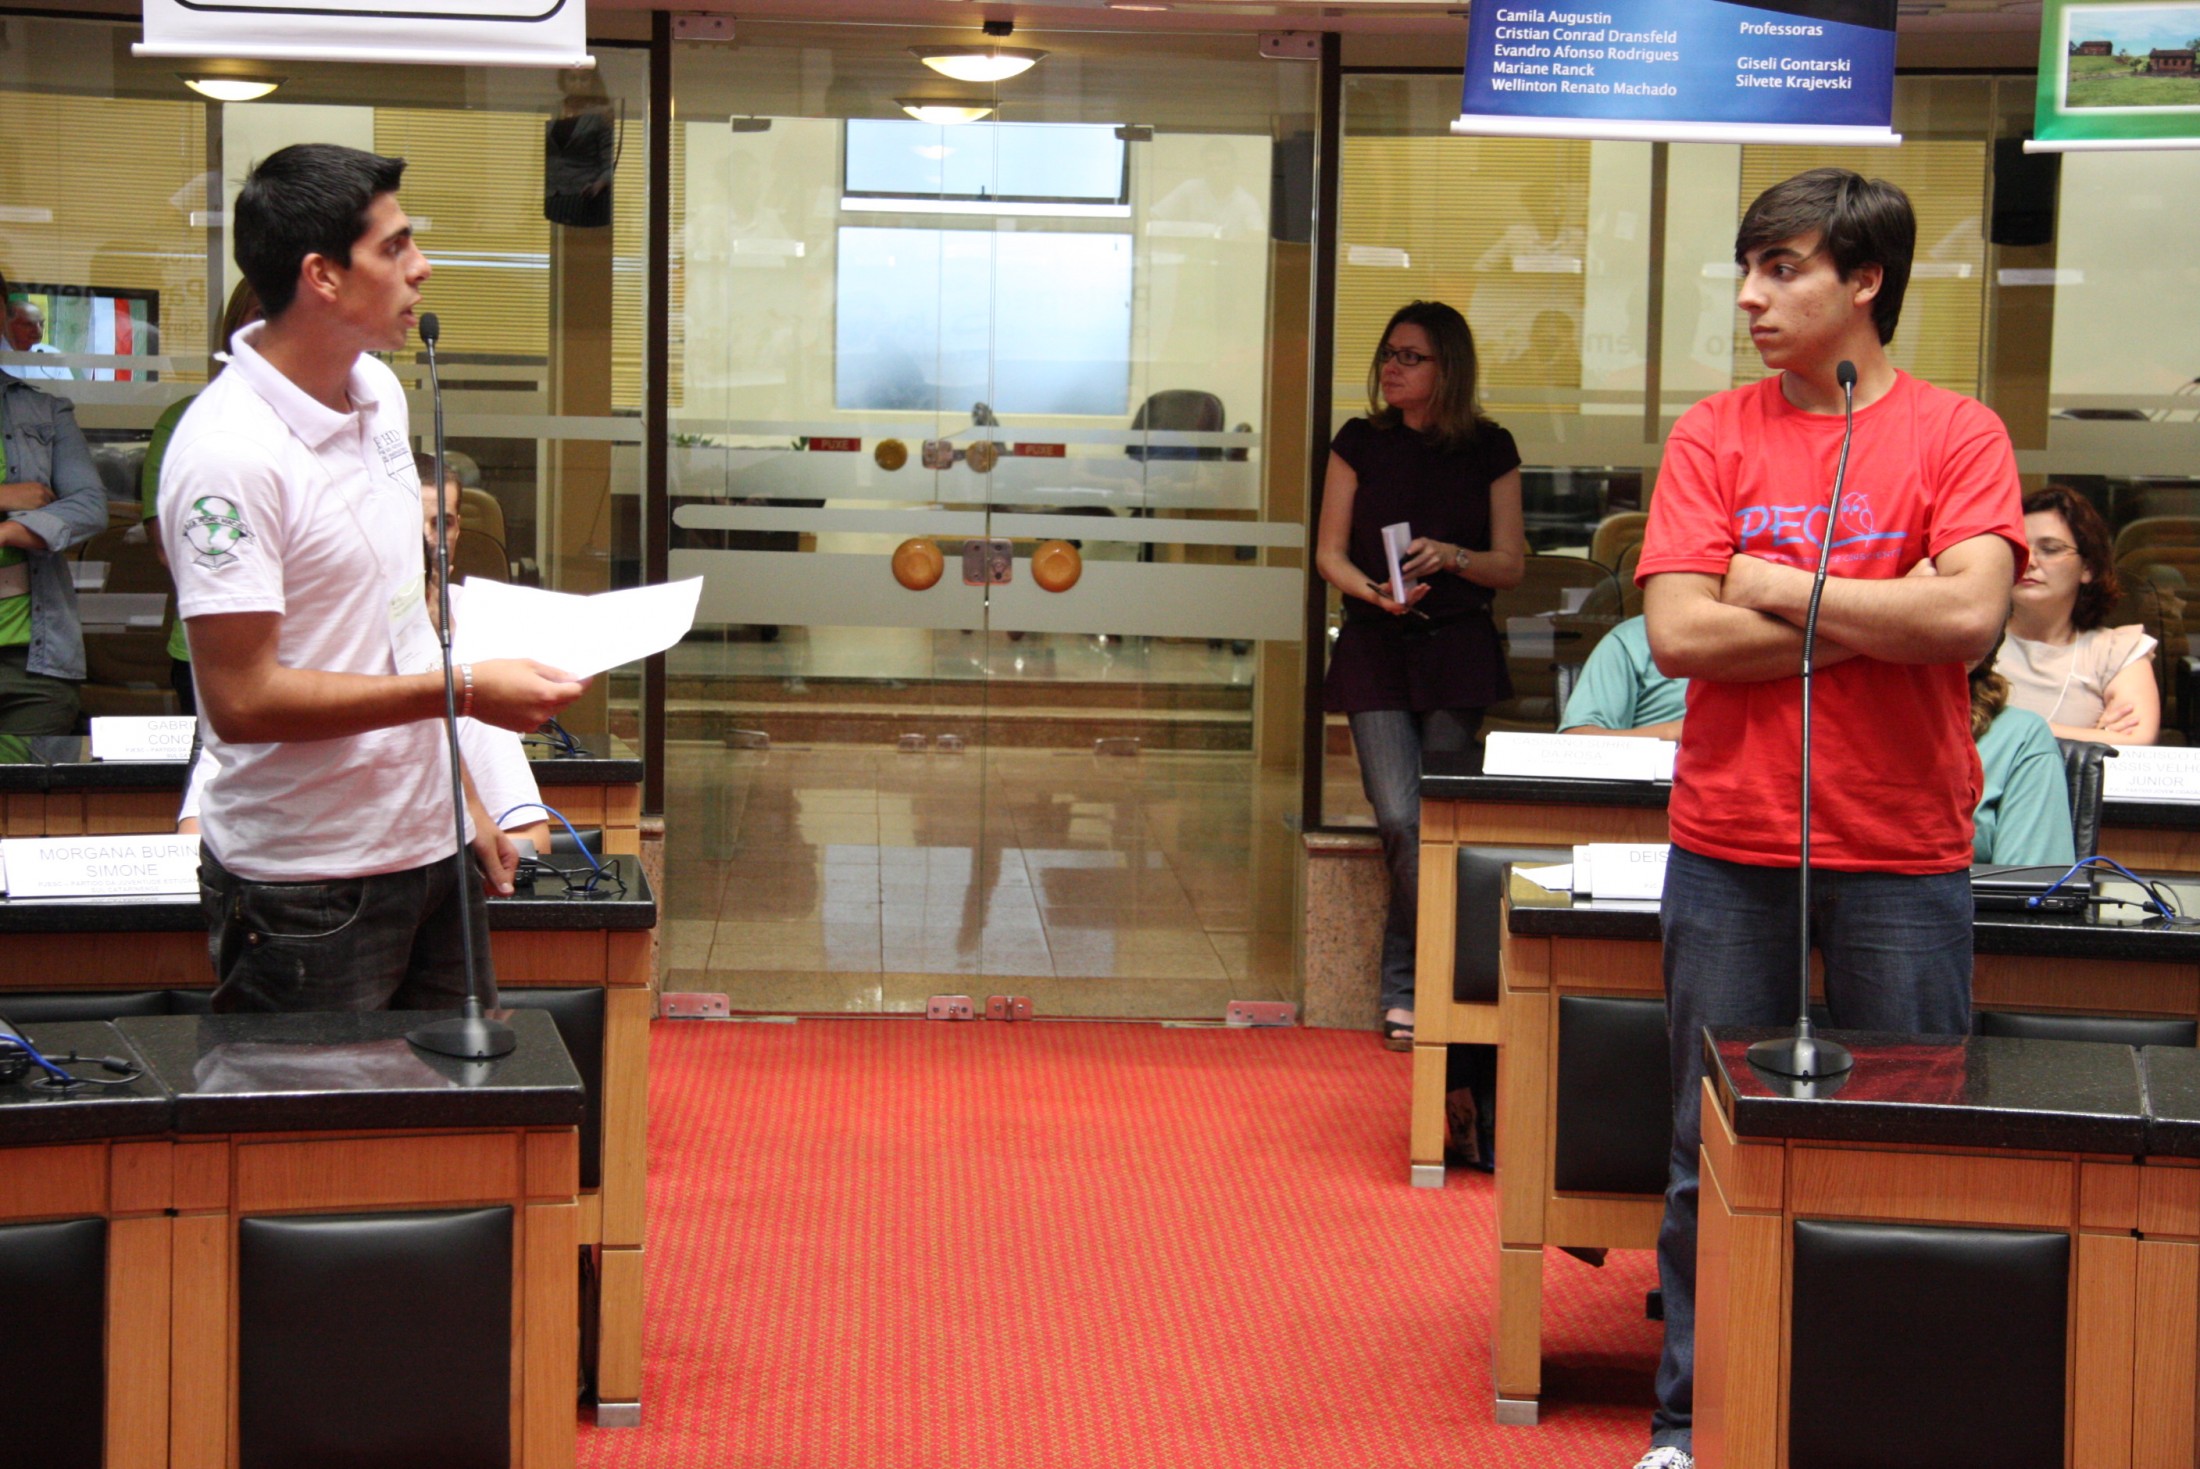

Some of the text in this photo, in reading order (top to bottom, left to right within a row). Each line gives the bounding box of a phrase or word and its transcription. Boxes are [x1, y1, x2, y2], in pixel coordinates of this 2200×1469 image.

[1496, 9, 1612, 26] Camila Augustin
[1495, 27, 1678, 44] Cristian Conrad Dransfeld
[1739, 21, 1823, 36] Professoras
[1494, 44, 1680, 63] Evandro Afonso Rodrigues
[1493, 61, 1596, 77] Mariane Ranck
[1736, 56, 1851, 72] Giseli Gontarski
[1491, 78, 1678, 96] Wellinton Renato Machado
[1735, 74, 1852, 91] Silvete Krajevski
[147, 720, 193, 731] GABRI
[148, 734, 192, 745] CONC
[2121, 751, 2190, 761] ANCISCO
[2128, 776, 2184, 787] JUNIOR
[39, 846, 137, 861] MORGANA
[1629, 850, 1668, 863] DEIS
[86, 863, 159, 878] SIMONE
